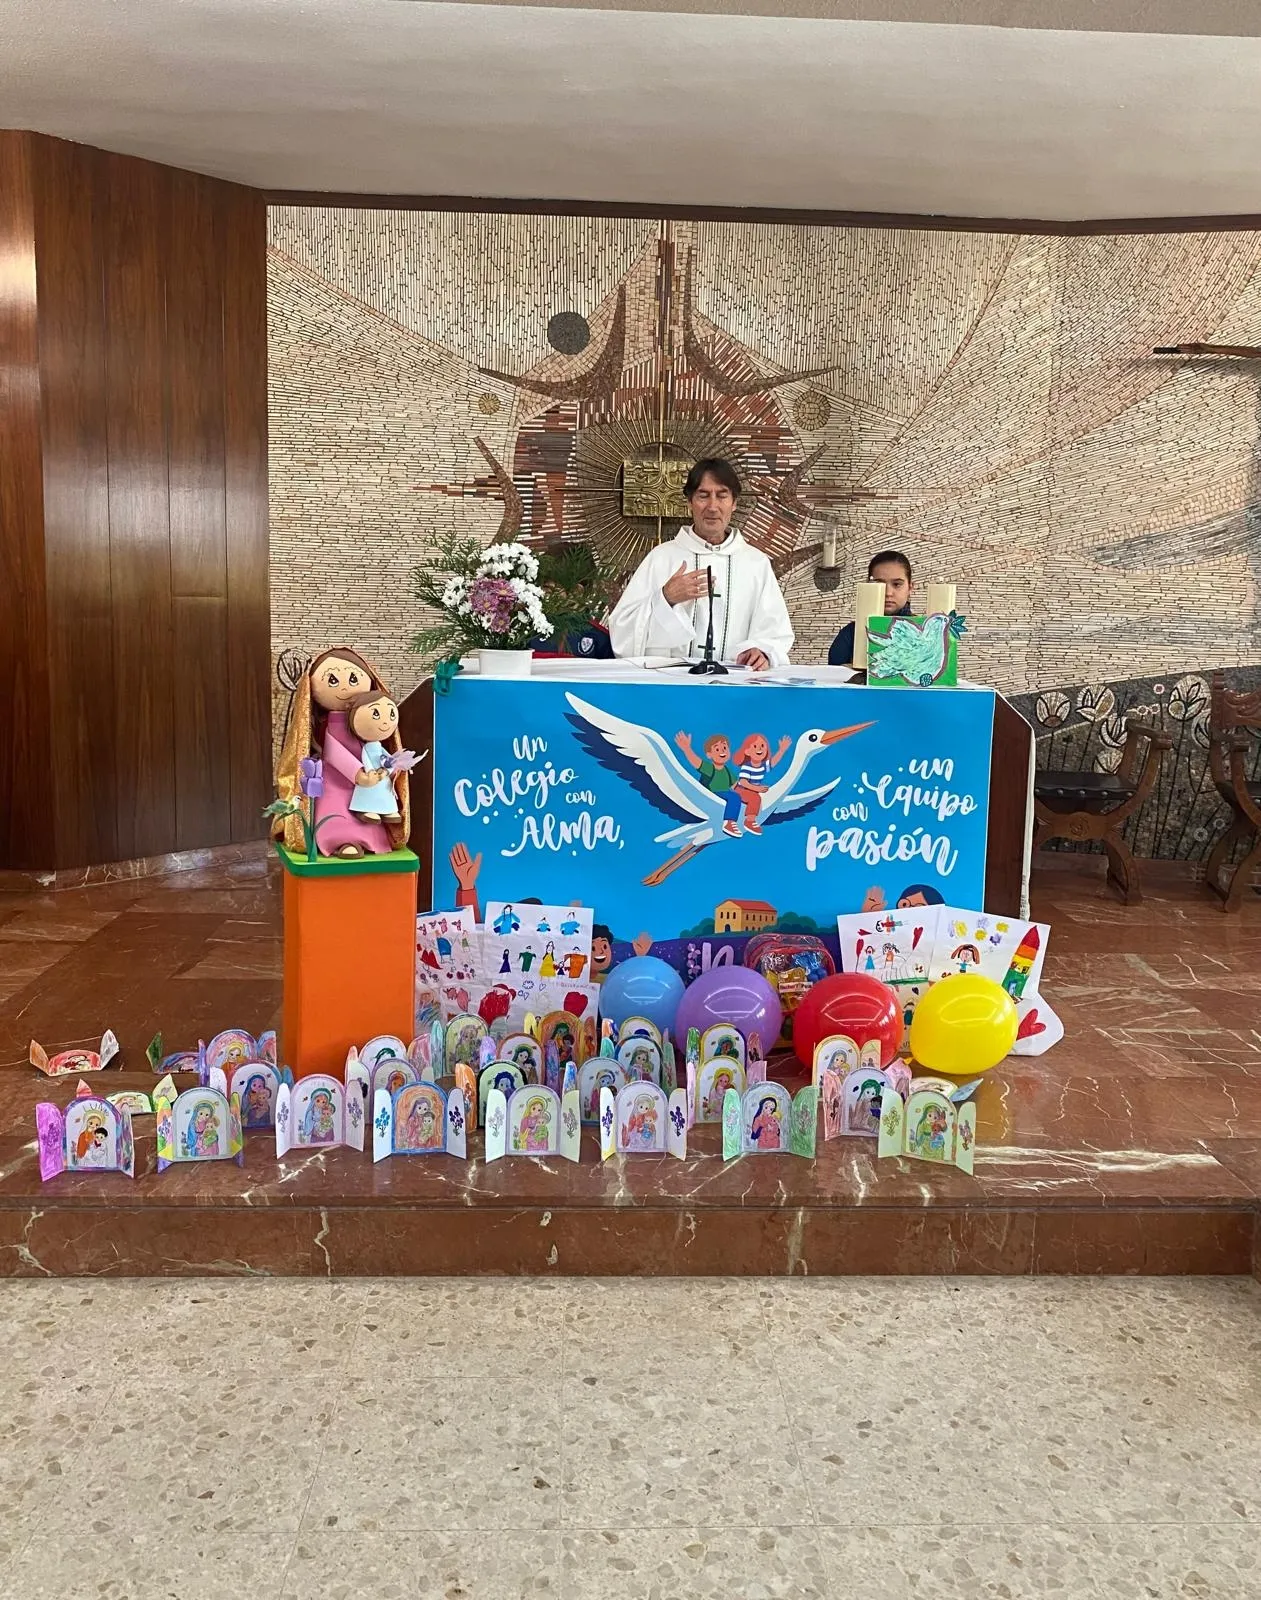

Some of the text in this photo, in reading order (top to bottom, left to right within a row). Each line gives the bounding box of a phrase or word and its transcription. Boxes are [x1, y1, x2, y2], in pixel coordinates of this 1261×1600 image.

[909, 758, 954, 781] un
[454, 761, 579, 817] Colegio
[565, 790, 596, 806] con
[832, 802, 869, 822] con
[501, 811, 625, 857] Alma,
[805, 824, 958, 876] pasión
